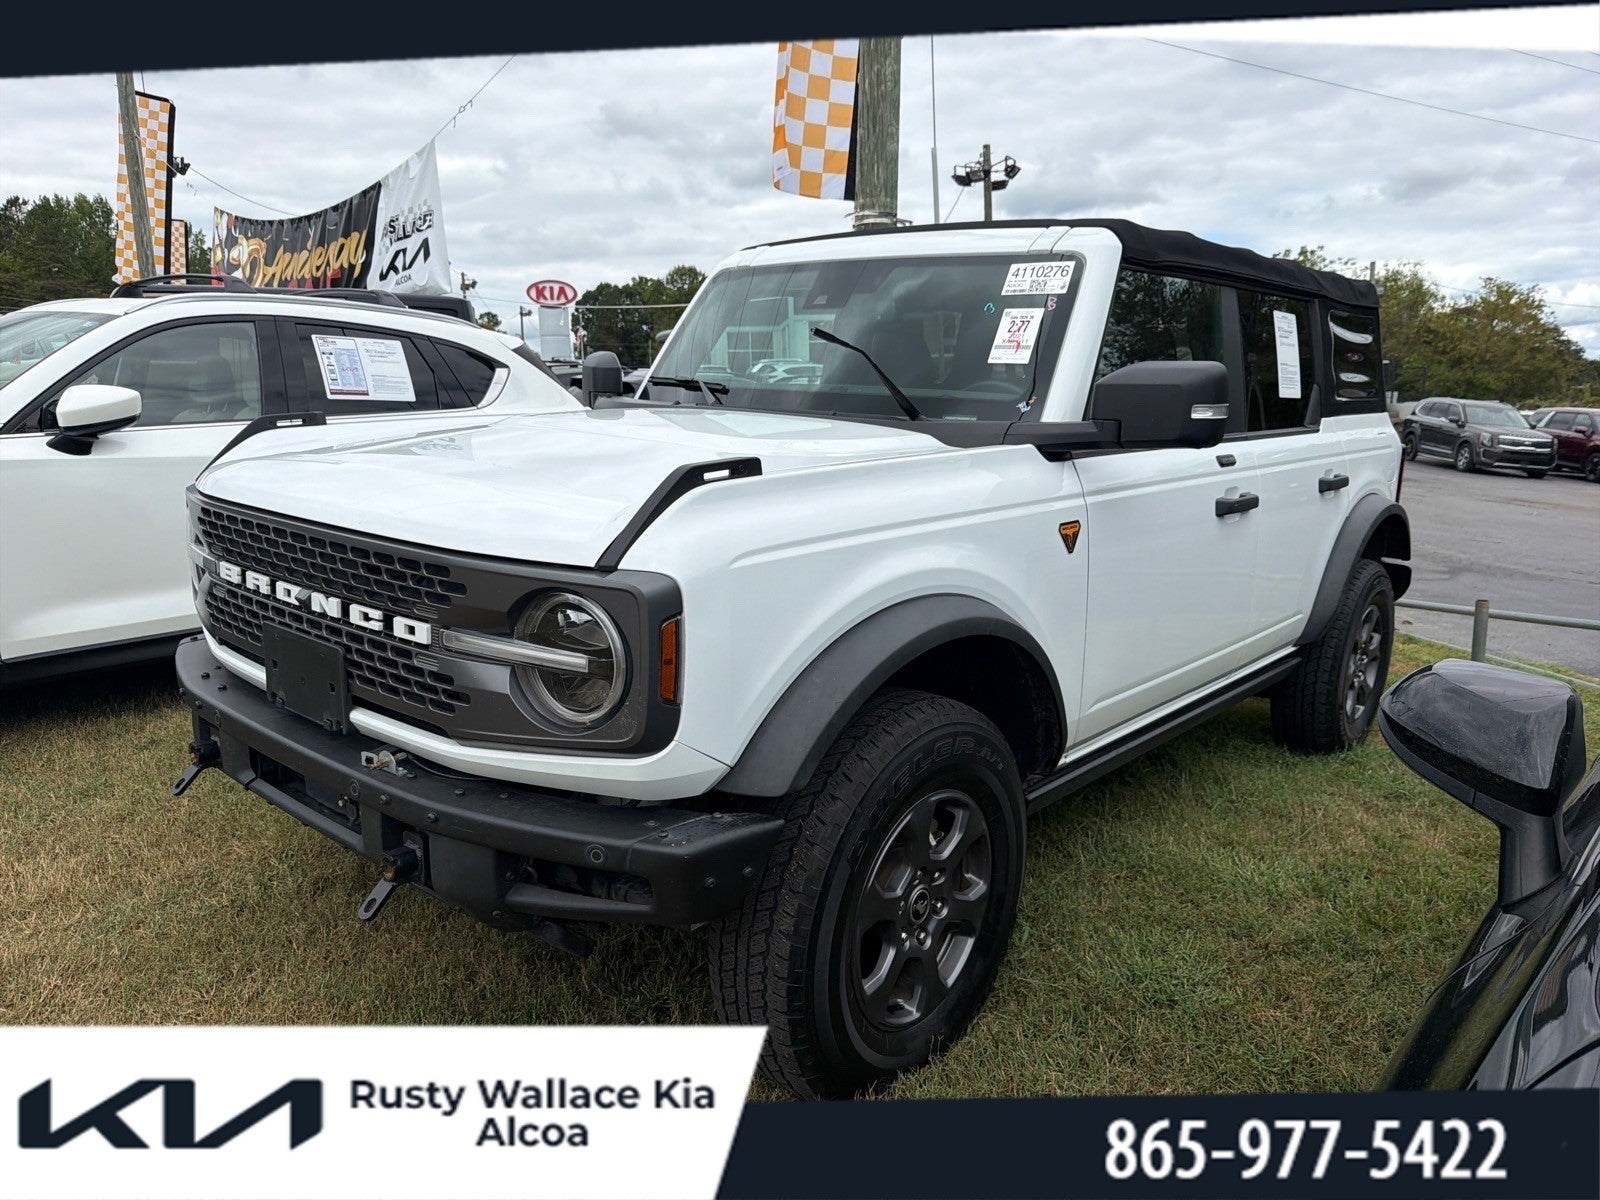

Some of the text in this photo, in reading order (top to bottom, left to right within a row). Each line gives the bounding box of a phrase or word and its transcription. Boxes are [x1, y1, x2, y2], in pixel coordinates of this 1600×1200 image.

[379, 237, 431, 282] KIA
[394, 273, 413, 287] ALCOA
[1011, 265, 1070, 279] 4110276
[534, 285, 570, 304] KIA
[219, 560, 432, 645] BRONCO
